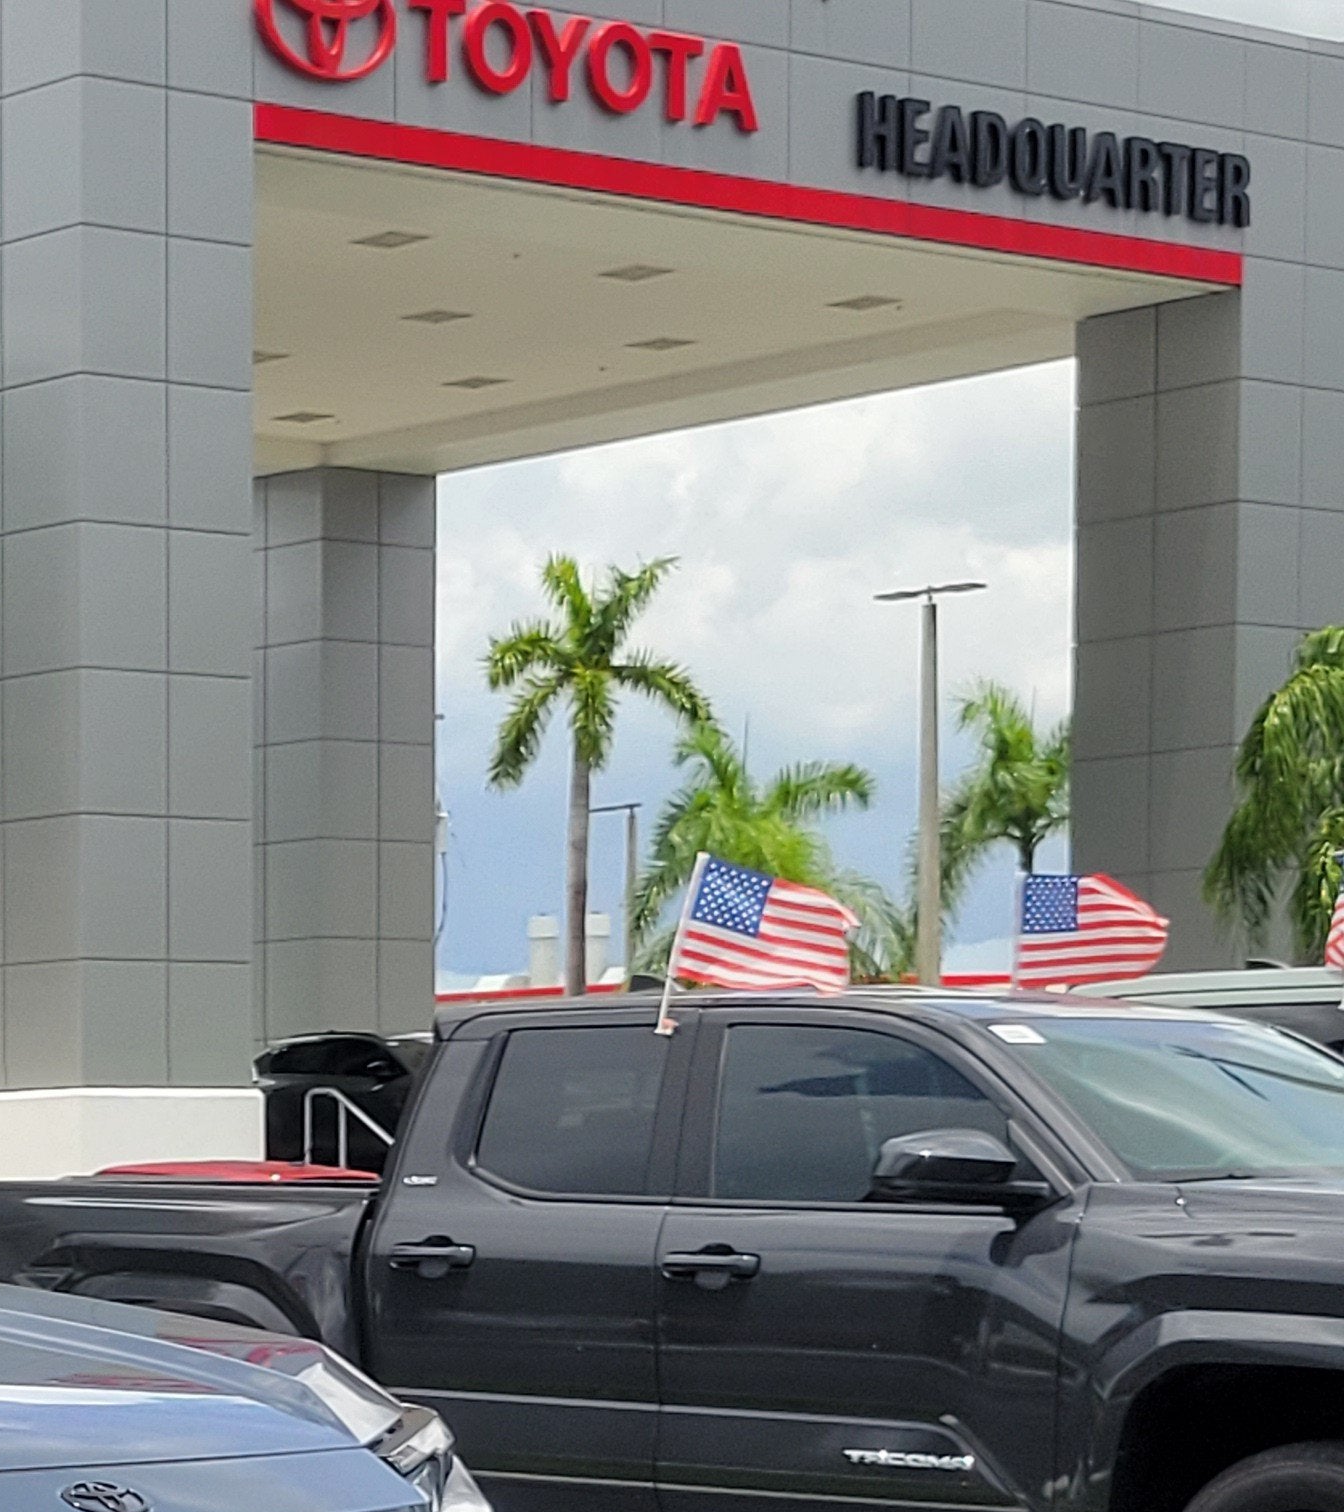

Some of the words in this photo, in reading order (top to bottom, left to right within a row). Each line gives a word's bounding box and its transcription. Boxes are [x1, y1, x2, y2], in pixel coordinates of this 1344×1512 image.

[408, 0, 759, 132] TOYOTA
[857, 91, 1251, 228] HEADQUARTER
[843, 1448, 975, 1471] TACOMA
